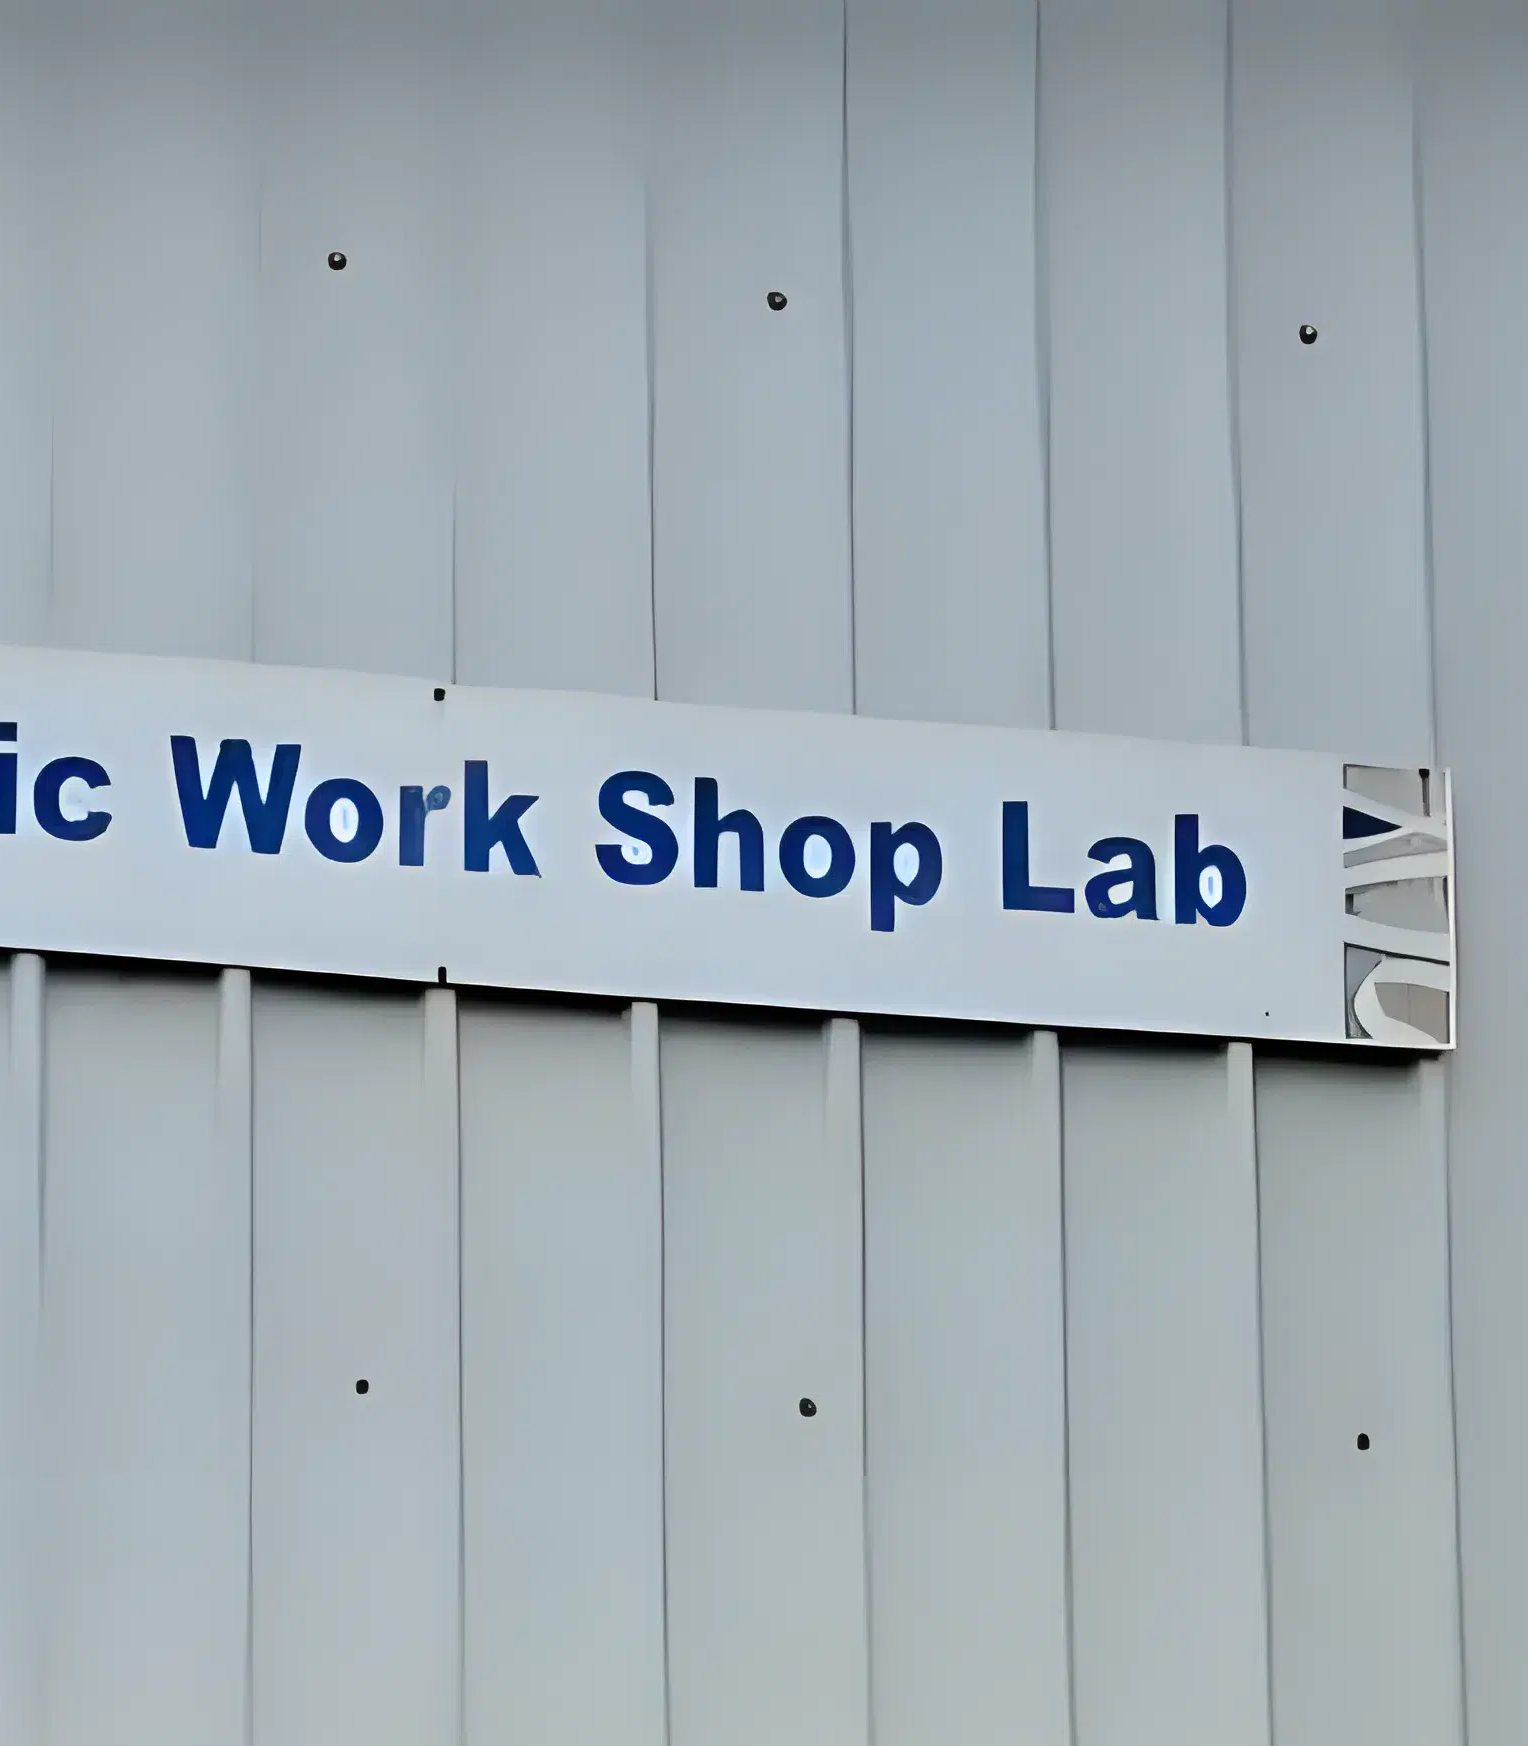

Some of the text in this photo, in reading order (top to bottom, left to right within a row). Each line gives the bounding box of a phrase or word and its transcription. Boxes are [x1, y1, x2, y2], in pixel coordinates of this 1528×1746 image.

[169, 734, 543, 878] Work
[595, 768, 944, 934] Shop
[1000, 800, 1249, 928] Lab
